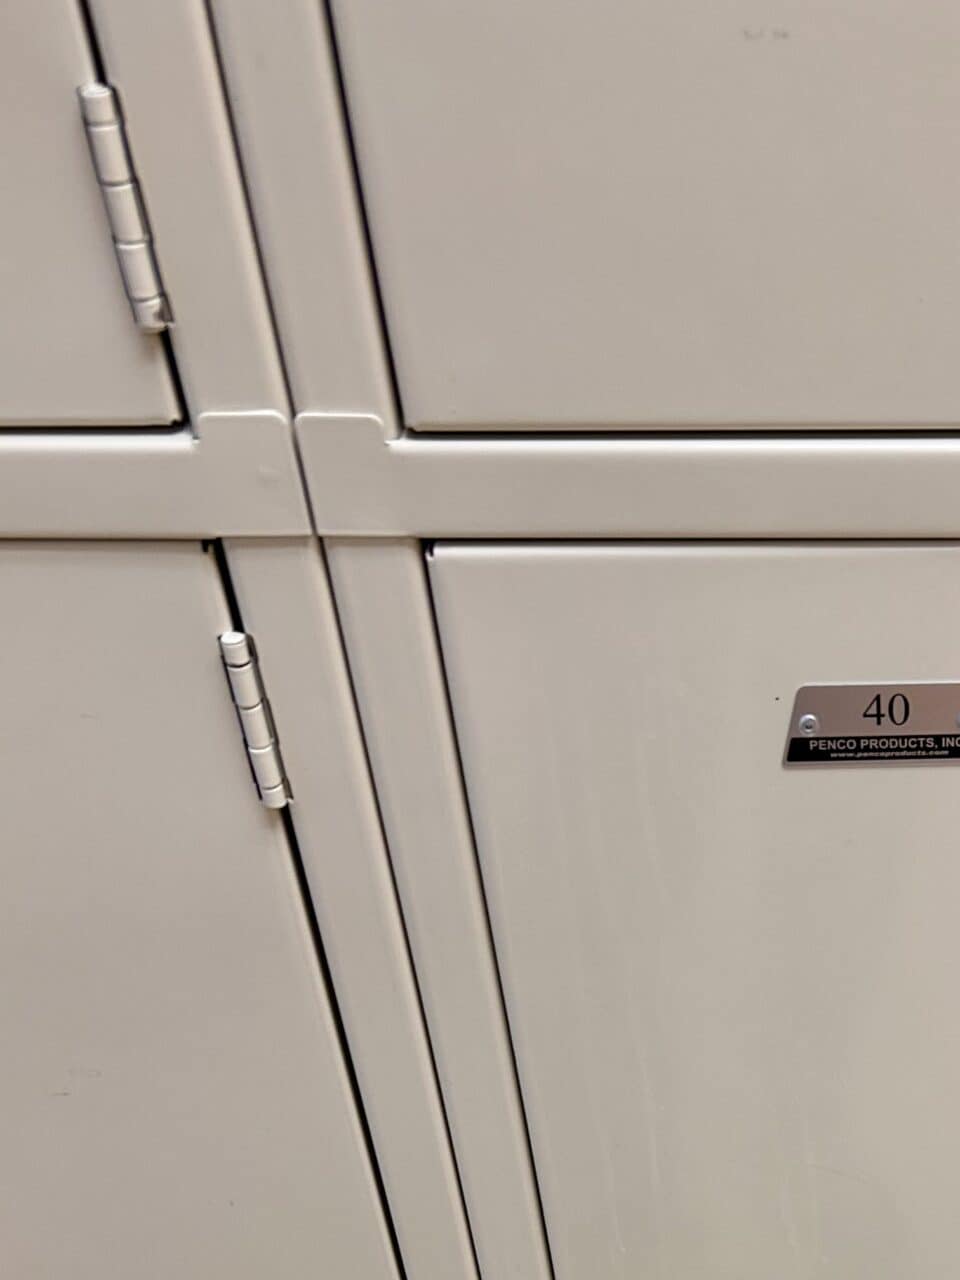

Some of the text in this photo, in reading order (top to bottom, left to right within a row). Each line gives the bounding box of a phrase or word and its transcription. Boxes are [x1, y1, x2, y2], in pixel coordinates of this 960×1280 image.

[862, 693, 910, 726] 40
[809, 739, 857, 751] PENCO
[860, 737, 938, 750] PRODUCTS,
